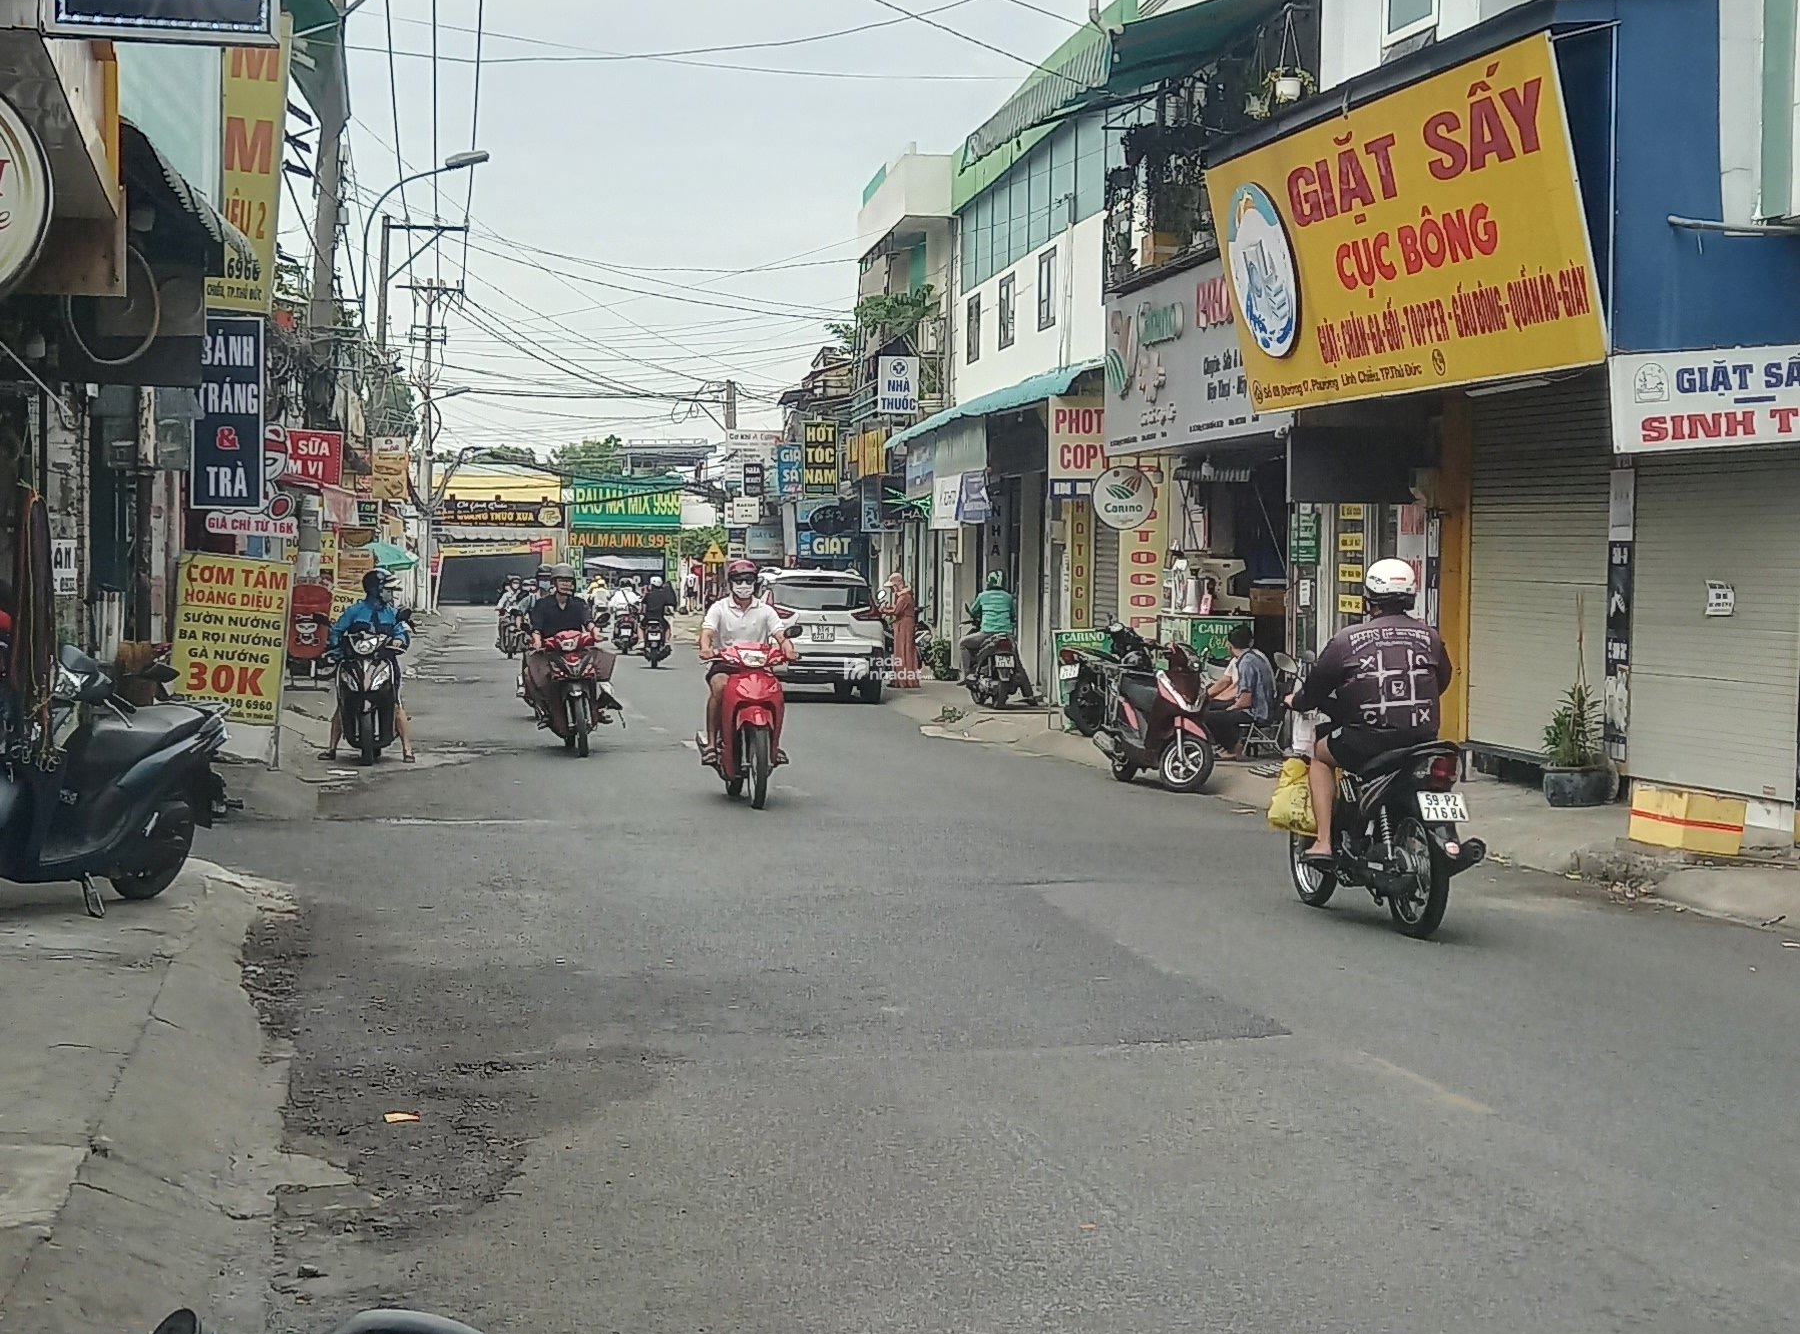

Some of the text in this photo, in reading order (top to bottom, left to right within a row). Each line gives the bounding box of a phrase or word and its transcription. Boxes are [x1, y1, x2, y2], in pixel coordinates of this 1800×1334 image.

[1287, 61, 1543, 228] GIẶT SẤY
[1335, 204, 1498, 299] CỤC BÔNG
[887, 376, 911, 393] NHÀ
[1676, 353, 1800, 397] GIẶT SẤ
[880, 394, 917, 411] THUỐC
[806, 424, 834, 443] HỚT
[1641, 410, 1756, 443] SINH
[216, 425, 241, 451] &
[297, 437, 331, 457] SỮA
[806, 444, 835, 464] TÓC
[206, 461, 249, 498] TRÀ
[805, 468, 836, 485] NAM
[575, 486, 603, 515] RAU
[186, 564, 289, 591] CƠM TẤM
[184, 586, 237, 606] HOÀNG
[276, 597, 286, 611] 2
[183, 612, 281, 631] SƯỜN NƯỚNG
[178, 629, 283, 648] BA RỌI NƯỚNG
[188, 645, 271, 665] GÀ NƯỚNG
[186, 661, 266, 697] 30K
[245, 699, 273, 712] 6960
